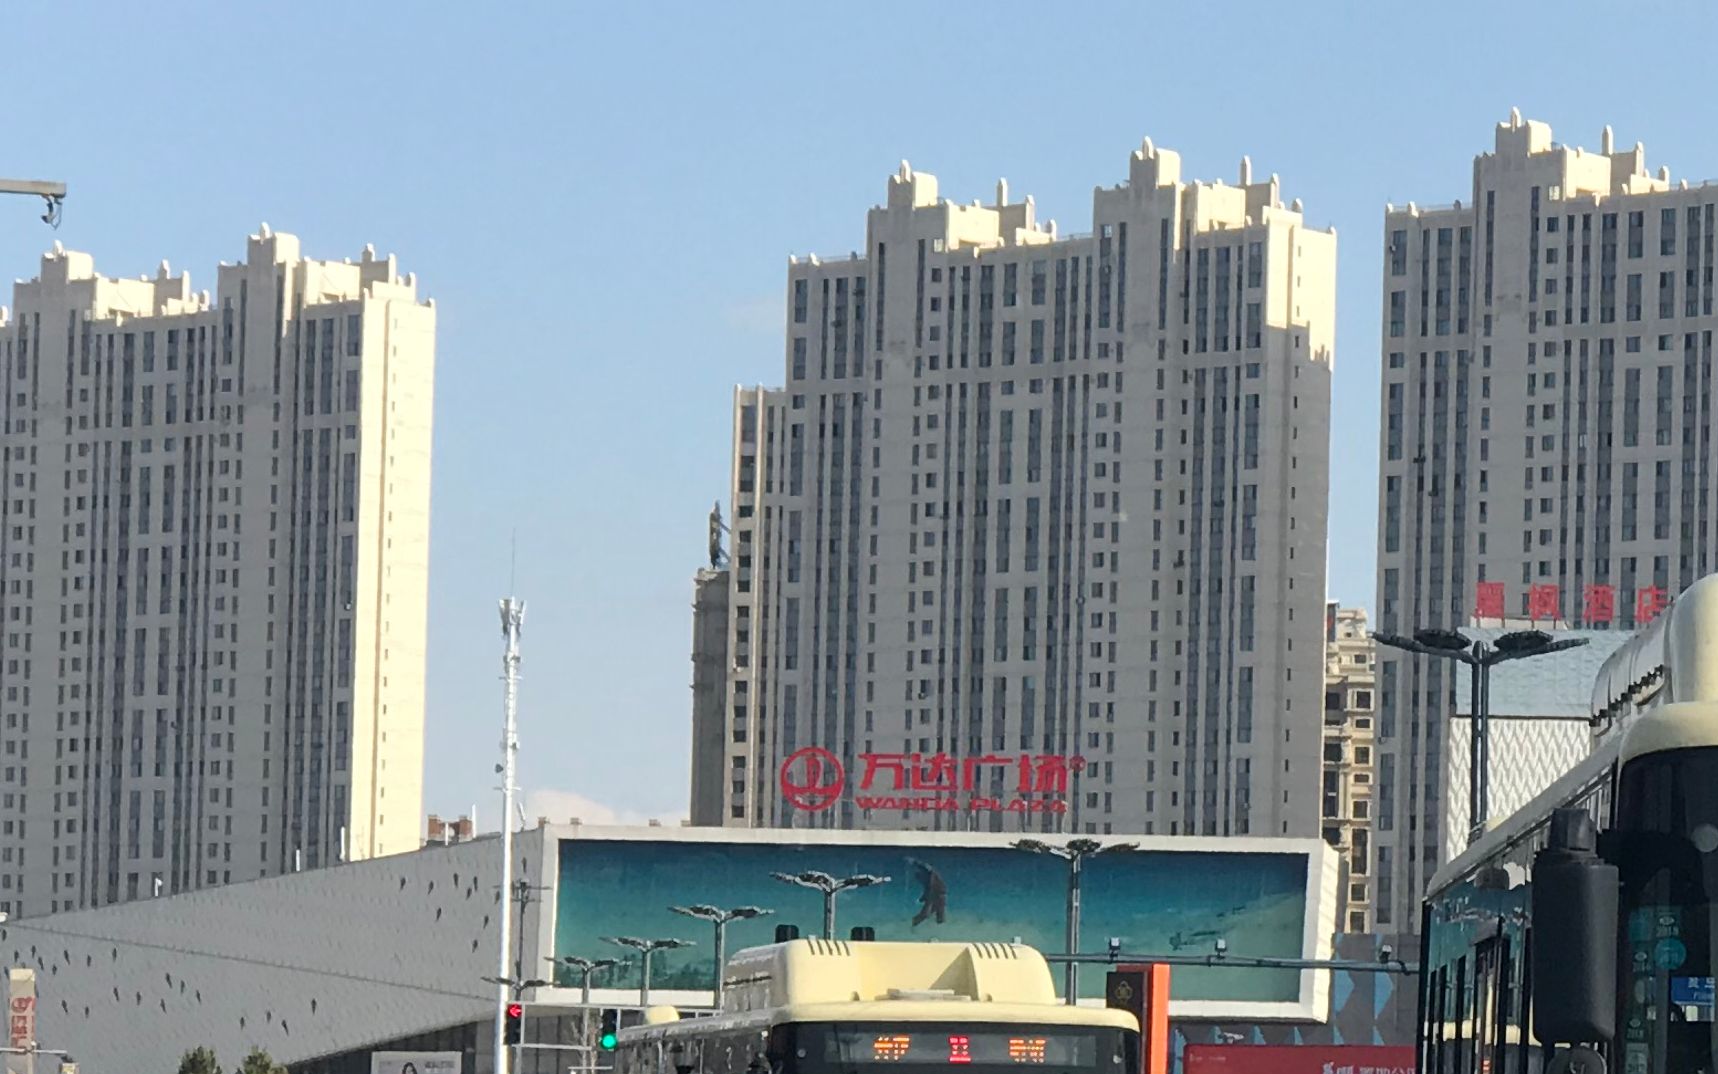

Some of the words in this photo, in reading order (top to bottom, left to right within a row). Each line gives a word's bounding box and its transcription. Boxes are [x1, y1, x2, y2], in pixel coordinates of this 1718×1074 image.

[858, 752, 1068, 792] 万达广场
[855, 796, 959, 811] WANDA
[971, 797, 1068, 814] PLAZA
